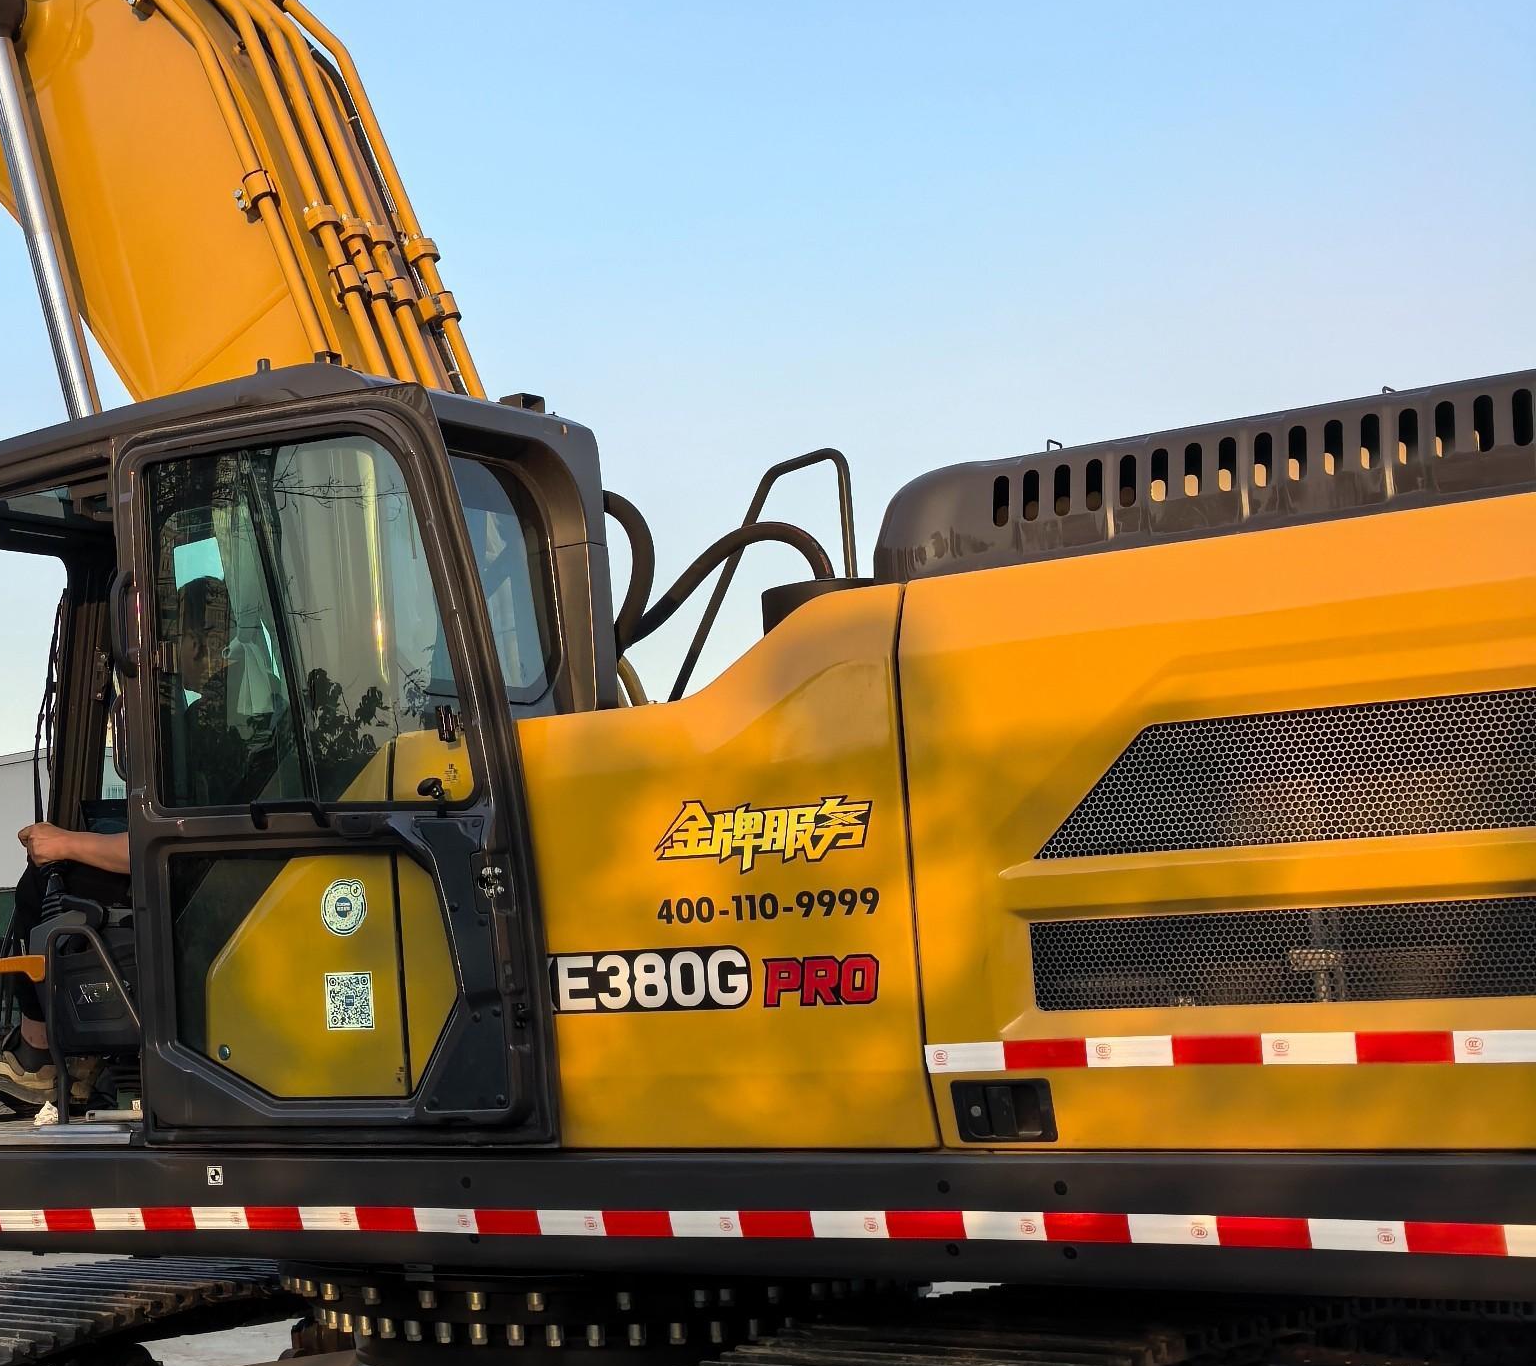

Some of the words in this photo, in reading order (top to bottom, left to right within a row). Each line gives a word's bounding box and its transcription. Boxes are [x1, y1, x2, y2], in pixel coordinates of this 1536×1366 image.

[654, 795, 873, 875] 金牌服务
[656, 887, 881, 925] 400-110-9999
[547, 949, 749, 1011] E380G
[763, 953, 880, 1009] PRO
